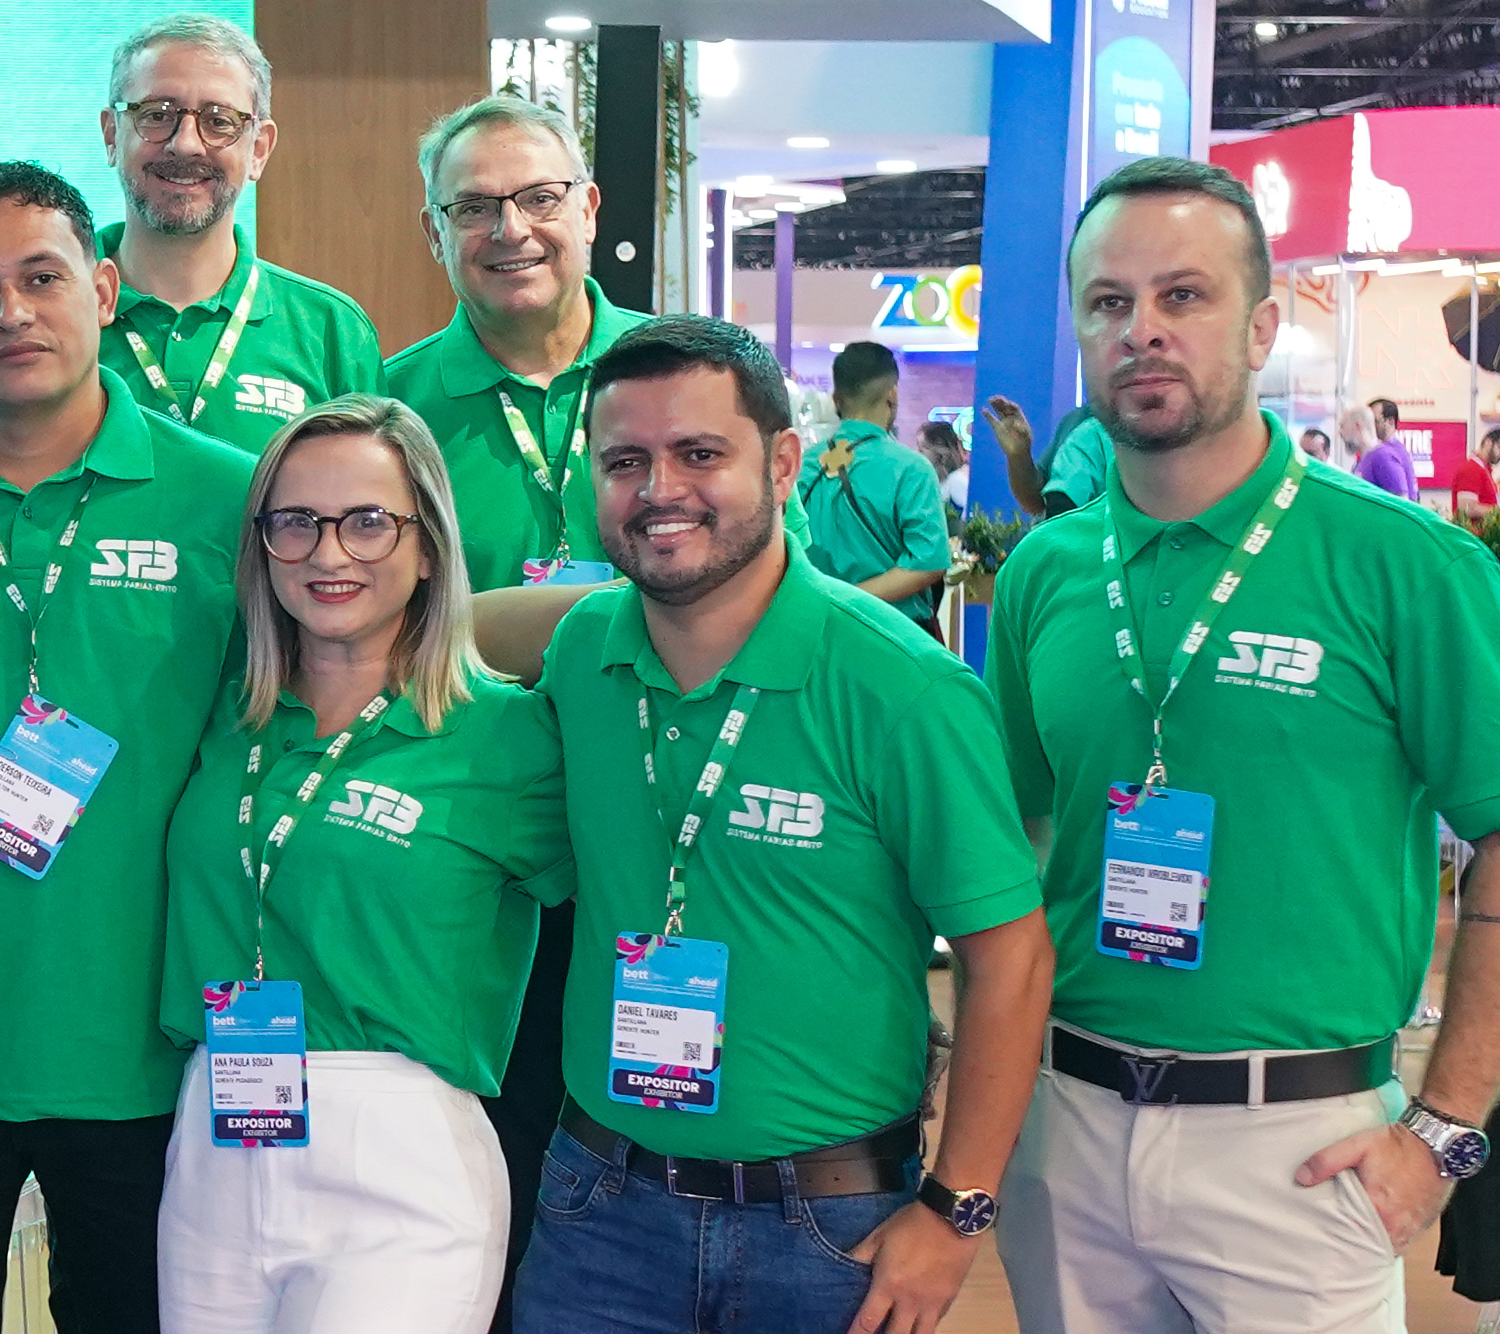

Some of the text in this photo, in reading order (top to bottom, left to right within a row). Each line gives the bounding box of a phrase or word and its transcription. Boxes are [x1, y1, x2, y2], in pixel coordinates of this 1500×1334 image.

[235, 374, 306, 415] SFB
[90, 539, 178, 581] SFB
[1218, 631, 1324, 684] SFB
[16, 724, 40, 743] bett
[329, 779, 423, 834] SFB
[729, 783, 824, 837] SFB
[1115, 927, 1185, 948] EXPOSITOR
[623, 967, 649, 980] bett
[213, 1016, 236, 1026] bett
[618, 1005, 678, 1021] DANIEL TAVARES
[214, 1058, 227, 1067] ANA
[230, 1058, 250, 1067] PAULA
[628, 1074, 700, 1093] EXPOSITOR
[228, 1118, 292, 1129] EXPOSITOR
